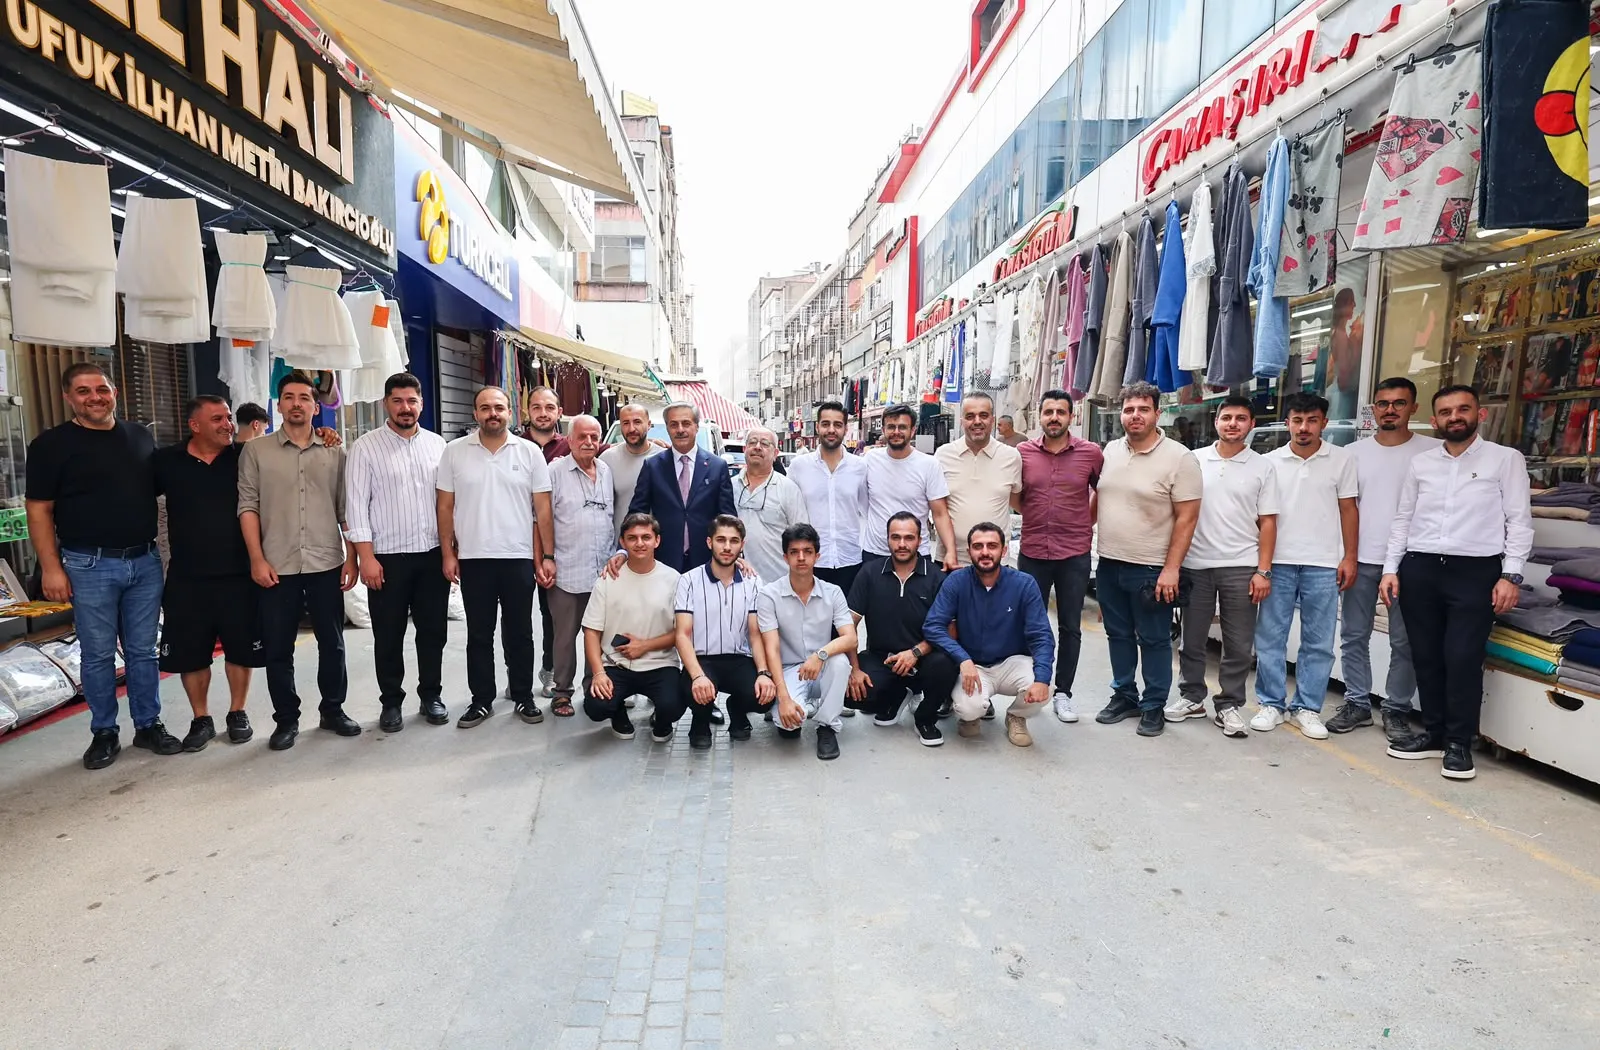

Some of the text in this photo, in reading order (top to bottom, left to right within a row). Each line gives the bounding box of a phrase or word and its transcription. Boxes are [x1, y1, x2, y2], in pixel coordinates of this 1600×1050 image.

[6, 0, 394, 257] UFUK İLHAN METİN BAKIRCIOĞLU
[201, 0, 354, 185] HALI
[1142, 4, 1401, 196] ÇAMAŞIRI
